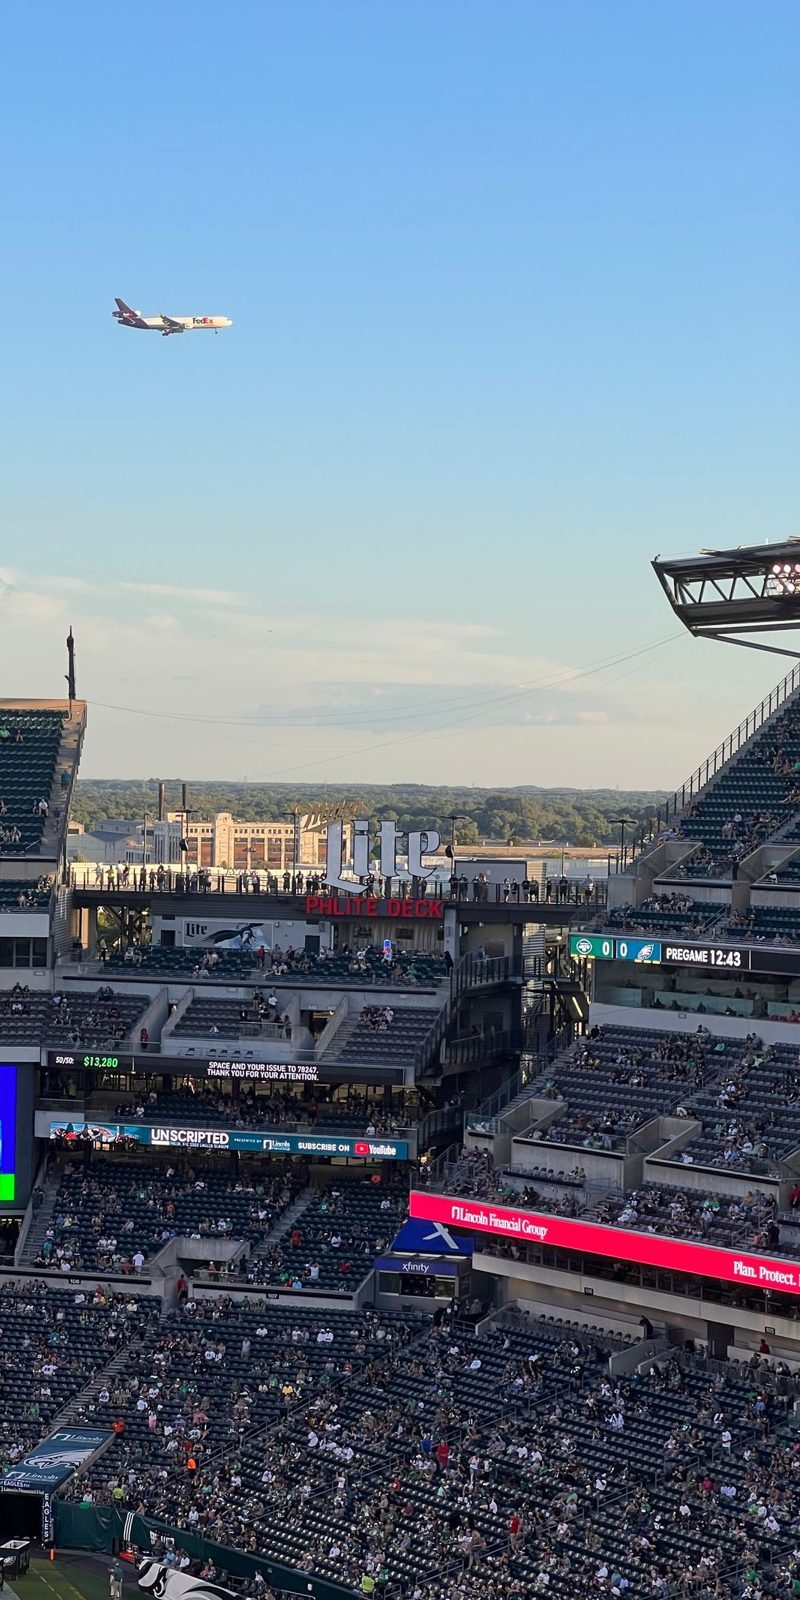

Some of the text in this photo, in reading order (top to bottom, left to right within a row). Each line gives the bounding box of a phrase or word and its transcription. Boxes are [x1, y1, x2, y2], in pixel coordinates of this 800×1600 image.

[192, 317, 213, 325] FedEx
[319, 818, 441, 894] Lite
[306, 896, 444, 919] PHLITE DECK
[185, 923, 208, 937] Lite
[602, 942, 610, 955] 0
[619, 943, 628, 957] 0
[666, 947, 741, 967] PREGAME 12:43
[83, 1056, 118, 1068] $13,280
[209, 1062, 319, 1074] SPACE AND YOUR ISSUE TO 78247.
[207, 1068, 230, 1077] THANK
[231, 1069, 245, 1077] YOU
[260, 1071, 279, 1079] YOUR
[279, 1072, 319, 1081] ATTENTION.
[151, 1128, 229, 1145] UNSCRIPTED
[298, 1142, 337, 1151] SUBSCRIBE
[338, 1143, 350, 1152] ON
[369, 1144, 397, 1156] YouTube
[460, 1207, 548, 1240] Lincoln Financial Group
[402, 1261, 430, 1273] xfinity
[733, 1260, 757, 1278] Plan.
[759, 1265, 797, 1286] Protect.
[3, 1480, 24, 1488] EAGLES
